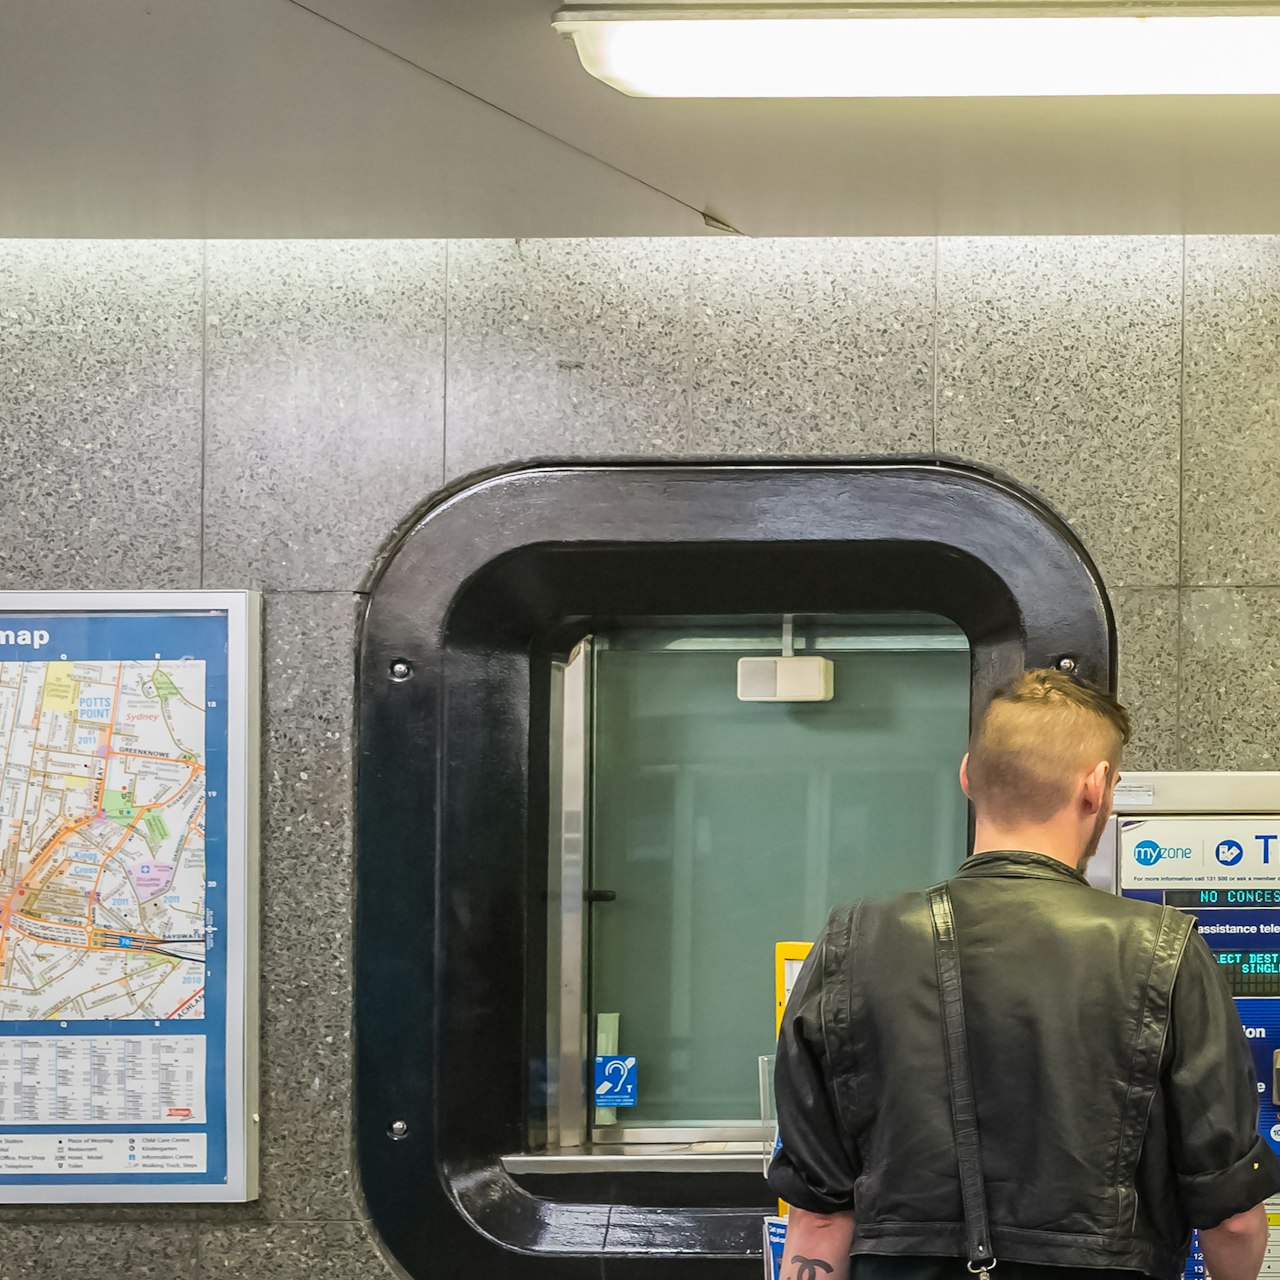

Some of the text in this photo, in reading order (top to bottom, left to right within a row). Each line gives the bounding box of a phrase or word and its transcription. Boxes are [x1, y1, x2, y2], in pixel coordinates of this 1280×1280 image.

[79, 697, 111, 707] POTTS
[79, 708, 110, 719] POINT
[126, 713, 159, 722] Sydney
[78, 736, 96, 745] 2011
[119, 746, 170, 758] GREENKNOWE
[94, 767, 104, 803] MACLEAY
[73, 852, 98, 861] Kings
[1134, 844, 1192, 864] myzone
[74, 866, 98, 874] Cross
[1200, 890, 1218, 903] NO
[1198, 923, 1257, 934] assistance
[182, 976, 202, 985] 2010
[1193, 1253, 1204, 1261] 12
[1193, 1265, 1204, 1273] 13
